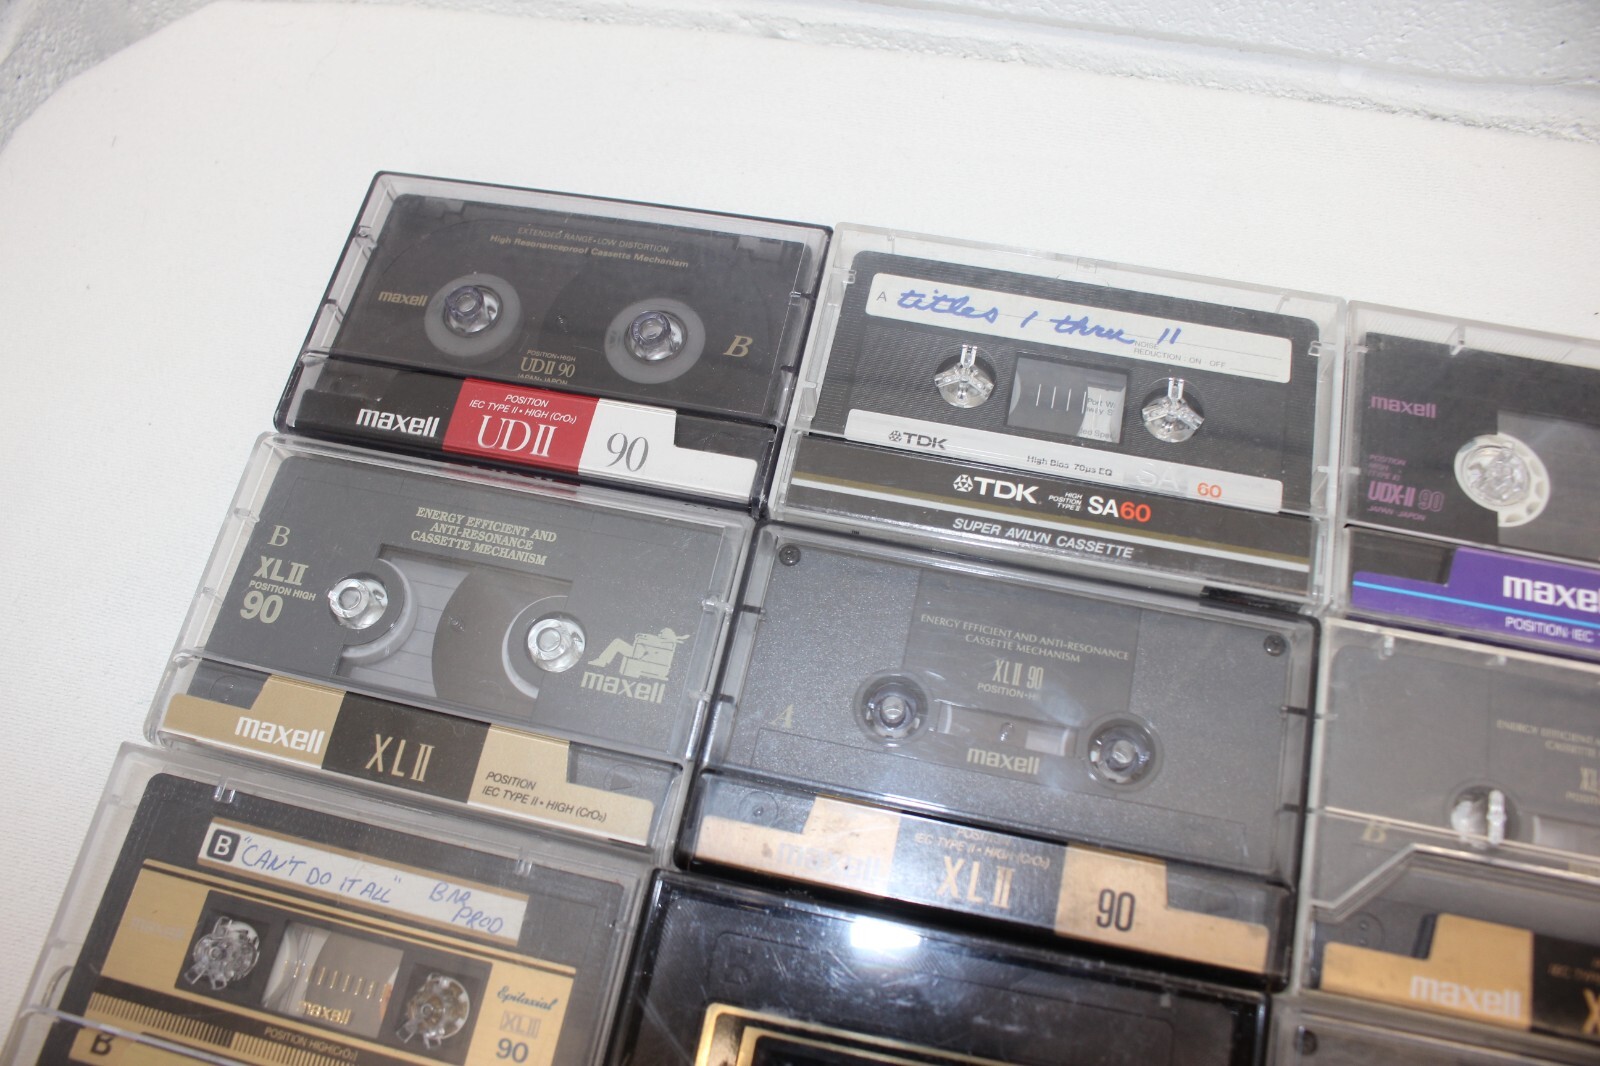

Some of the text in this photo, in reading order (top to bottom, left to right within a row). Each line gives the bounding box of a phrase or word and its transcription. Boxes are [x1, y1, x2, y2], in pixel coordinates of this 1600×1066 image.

[490, 234, 689, 268] High Resonanceproof Cassette Mechanism
[517, 227, 669, 253] EXTENDED RANGE LOW DISTORTION
[378, 291, 428, 307] maxell
[876, 290, 888, 303] A
[723, 334, 753, 357] B
[1133, 348, 1182, 361] REDUCTION
[1209, 360, 1226, 368] OFF
[1134, 340, 1160, 350] NOISE
[558, 362, 576, 378] 90
[469, 399, 486, 410] IEC
[487, 402, 510, 414] TYPE
[525, 408, 549, 420] HIGH
[504, 394, 549, 408] POSITION
[1370, 395, 1437, 419] maxell
[356, 408, 440, 438] maxell
[606, 432, 649, 472] 90
[900, 431, 948, 452] TDK
[1026, 455, 1048, 466] High
[973, 476, 1040, 505] TDK
[1048, 494, 1082, 506] POSITION
[1064, 491, 1084, 500] HIGH
[1197, 482, 1222, 499] 60
[1418, 489, 1444, 512] 90
[267, 524, 291, 547] B
[416, 506, 558, 543] ENERGY EFFICIENT AND
[430, 522, 534, 551] ANTI-RESONANCE
[410, 530, 548, 566] CASSETTE MECHANISM
[952, 517, 1134, 559] SUPER AVILYN CASSETTE
[248, 580, 317, 601] POSITION HIGH
[1502, 575, 1600, 615] maxe
[240, 590, 284, 624] 90
[920, 614, 1130, 661] ENERGY EFFICIENT AND ANTI-RESONANCE
[1504, 616, 1595, 644] POSITION IEC
[965, 634, 1081, 664] CASSETTE MECHANISM
[580, 671, 666, 704] maxell
[976, 682, 1024, 698] POSITION
[1026, 665, 1044, 690] 90
[768, 704, 794, 730] A
[234, 716, 326, 754] maxell
[966, 748, 1040, 776] maxell
[485, 771, 536, 790] POSITION
[482, 786, 500, 797] IEC
[502, 790, 530, 805] TYPE
[546, 800, 575, 814] HIGH
[214, 834, 233, 858] B
[938, 836, 967, 852] TYPE
[776, 842, 882, 881] maxell
[306, 866, 332, 886] DO
[340, 877, 362, 895] IT
[452, 902, 504, 935] PROD
[1096, 888, 1136, 932] 90
[1409, 974, 1522, 1020] maxell
[264, 1026, 308, 1047] POSITION
[496, 1037, 529, 1064] 90
